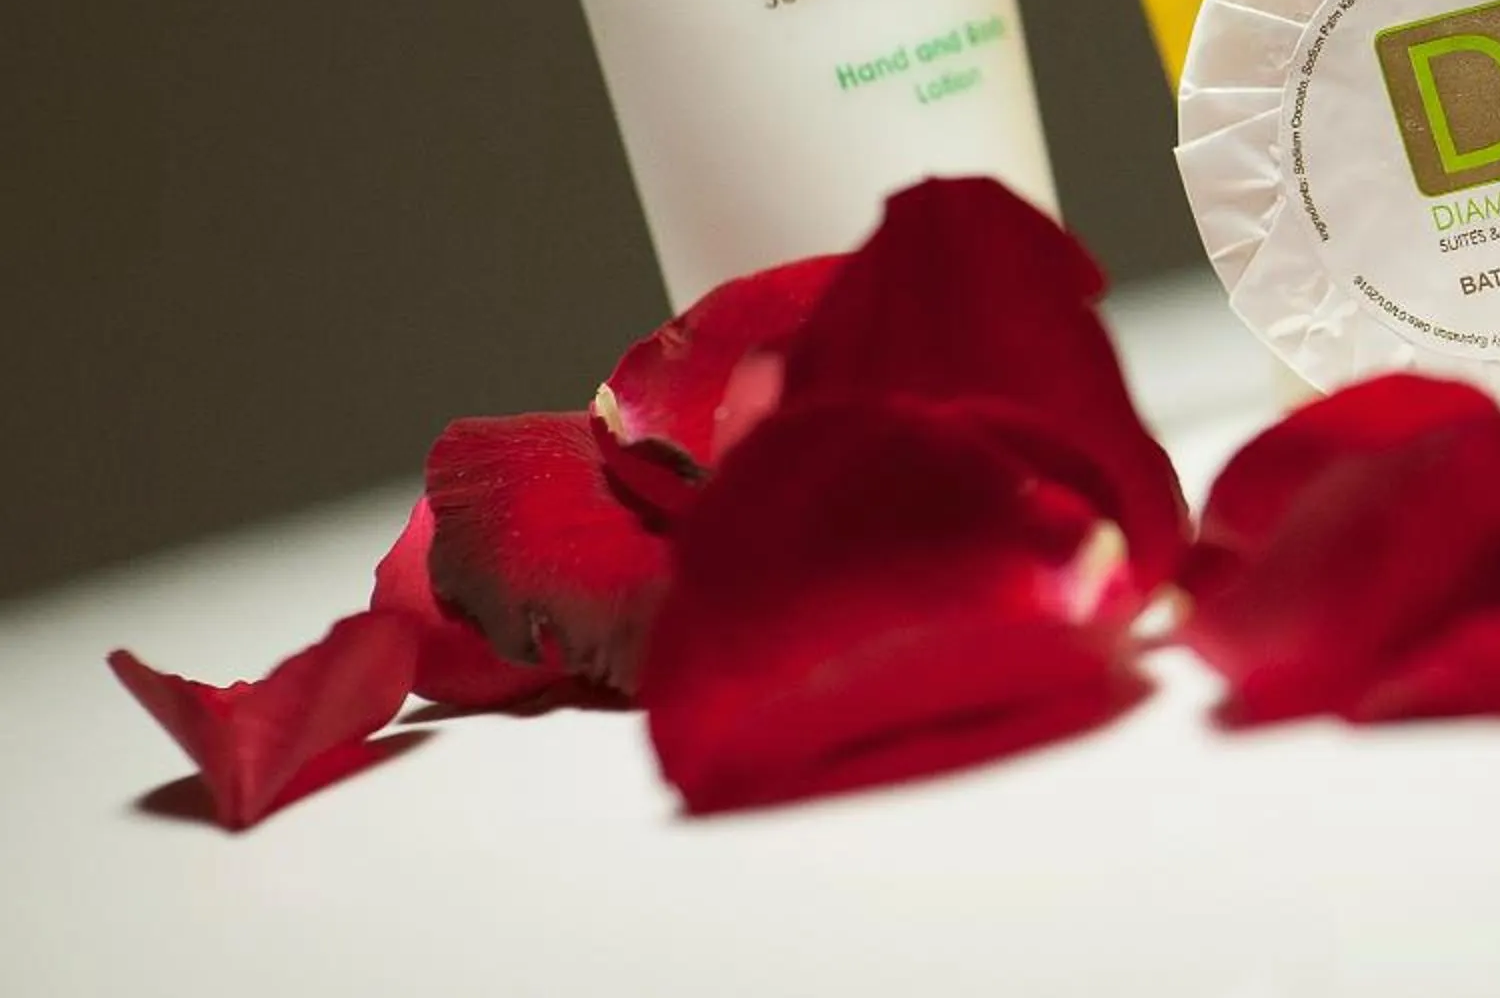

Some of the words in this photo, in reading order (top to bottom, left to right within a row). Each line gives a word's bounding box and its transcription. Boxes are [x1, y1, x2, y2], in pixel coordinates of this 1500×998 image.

[835, 45, 909, 90] Hand
[915, 31, 963, 62] and
[1439, 228, 1487, 253] SUITES
[1489, 227, 1500, 241] &
